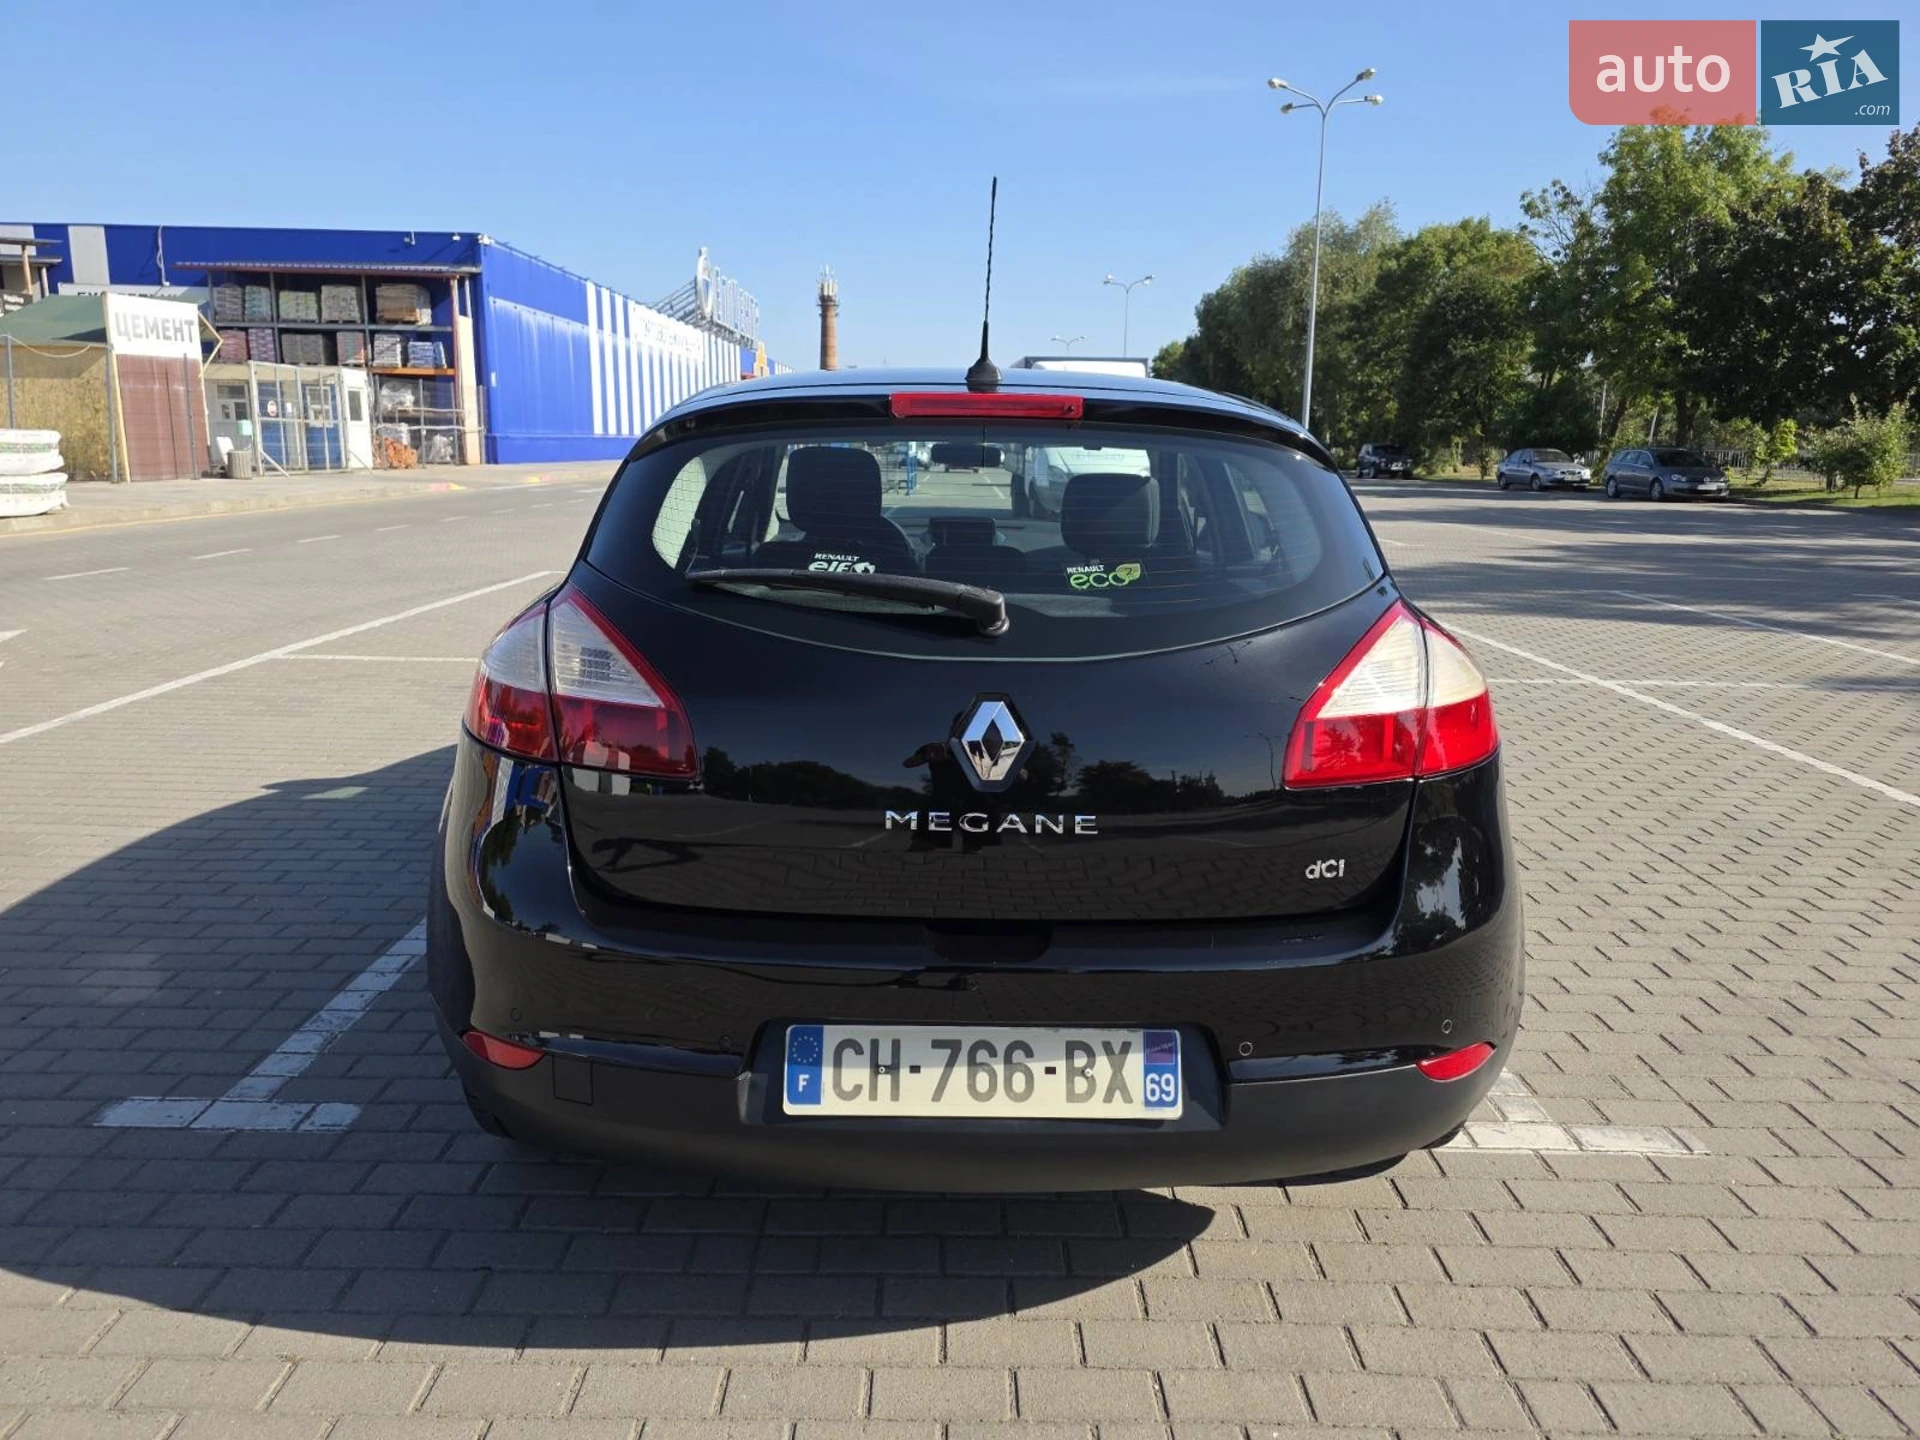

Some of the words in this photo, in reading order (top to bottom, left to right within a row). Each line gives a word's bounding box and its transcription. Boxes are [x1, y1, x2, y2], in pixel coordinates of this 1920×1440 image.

[114, 312, 195, 343] ЦЕМЕНТ
[814, 552, 860, 562] RENAULT
[1066, 564, 1105, 574] RENAULT
[884, 810, 1099, 835] MEGANE
[798, 1074, 810, 1093] F
[1145, 1073, 1176, 1102] 69
